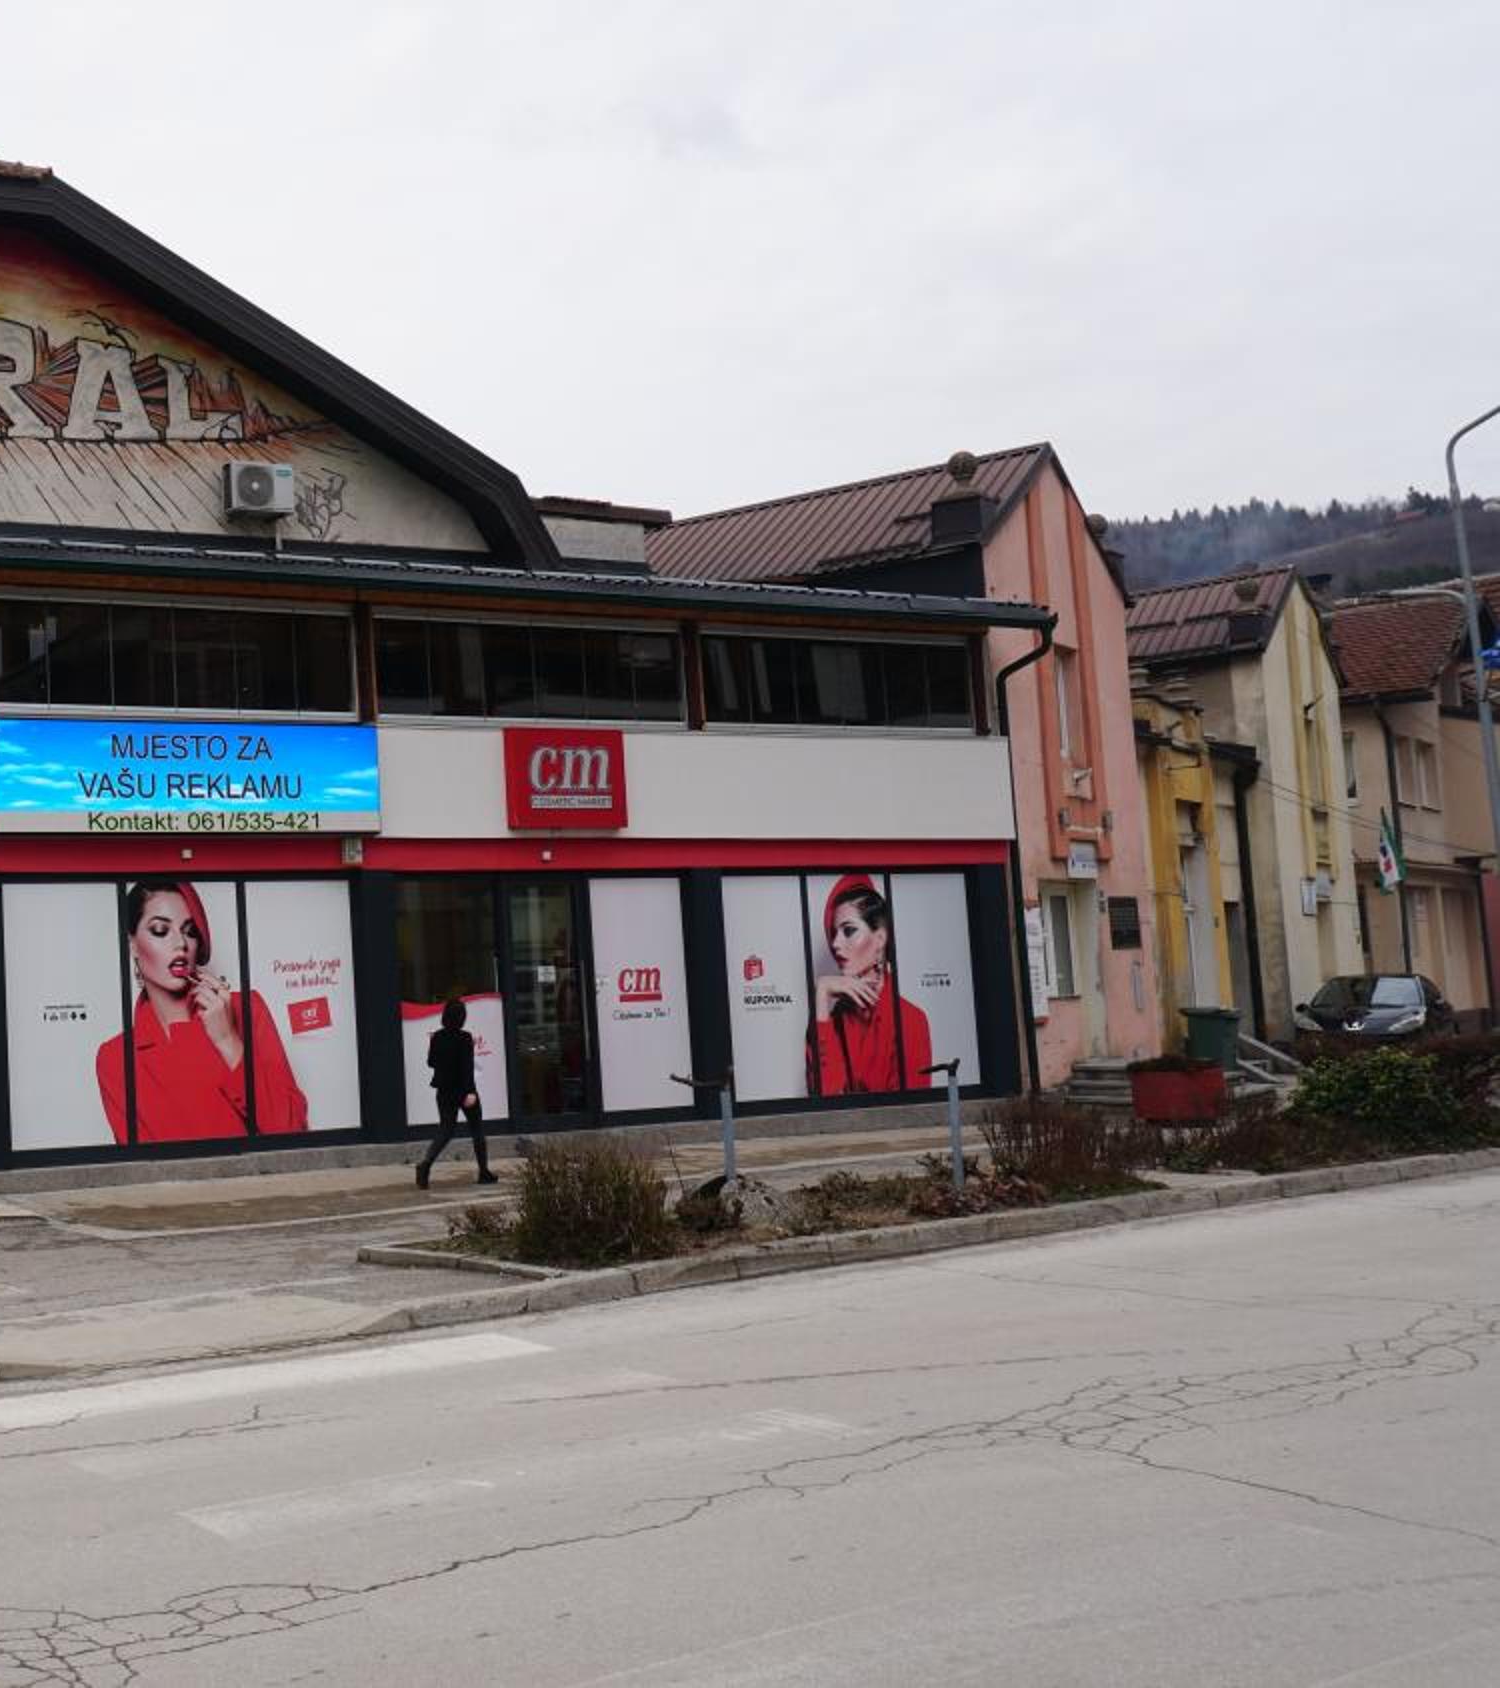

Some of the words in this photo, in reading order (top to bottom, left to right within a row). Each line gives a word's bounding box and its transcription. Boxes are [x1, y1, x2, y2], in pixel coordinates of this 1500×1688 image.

[110, 734, 228, 761] MJESTO
[236, 736, 273, 761] ZA
[530, 746, 611, 791] cm
[77, 767, 156, 800] VAŠU
[166, 773, 302, 800] REKLAMU
[87, 811, 180, 831] Kontakt:
[187, 811, 321, 831] 061/535-421
[618, 967, 661, 993] cm
